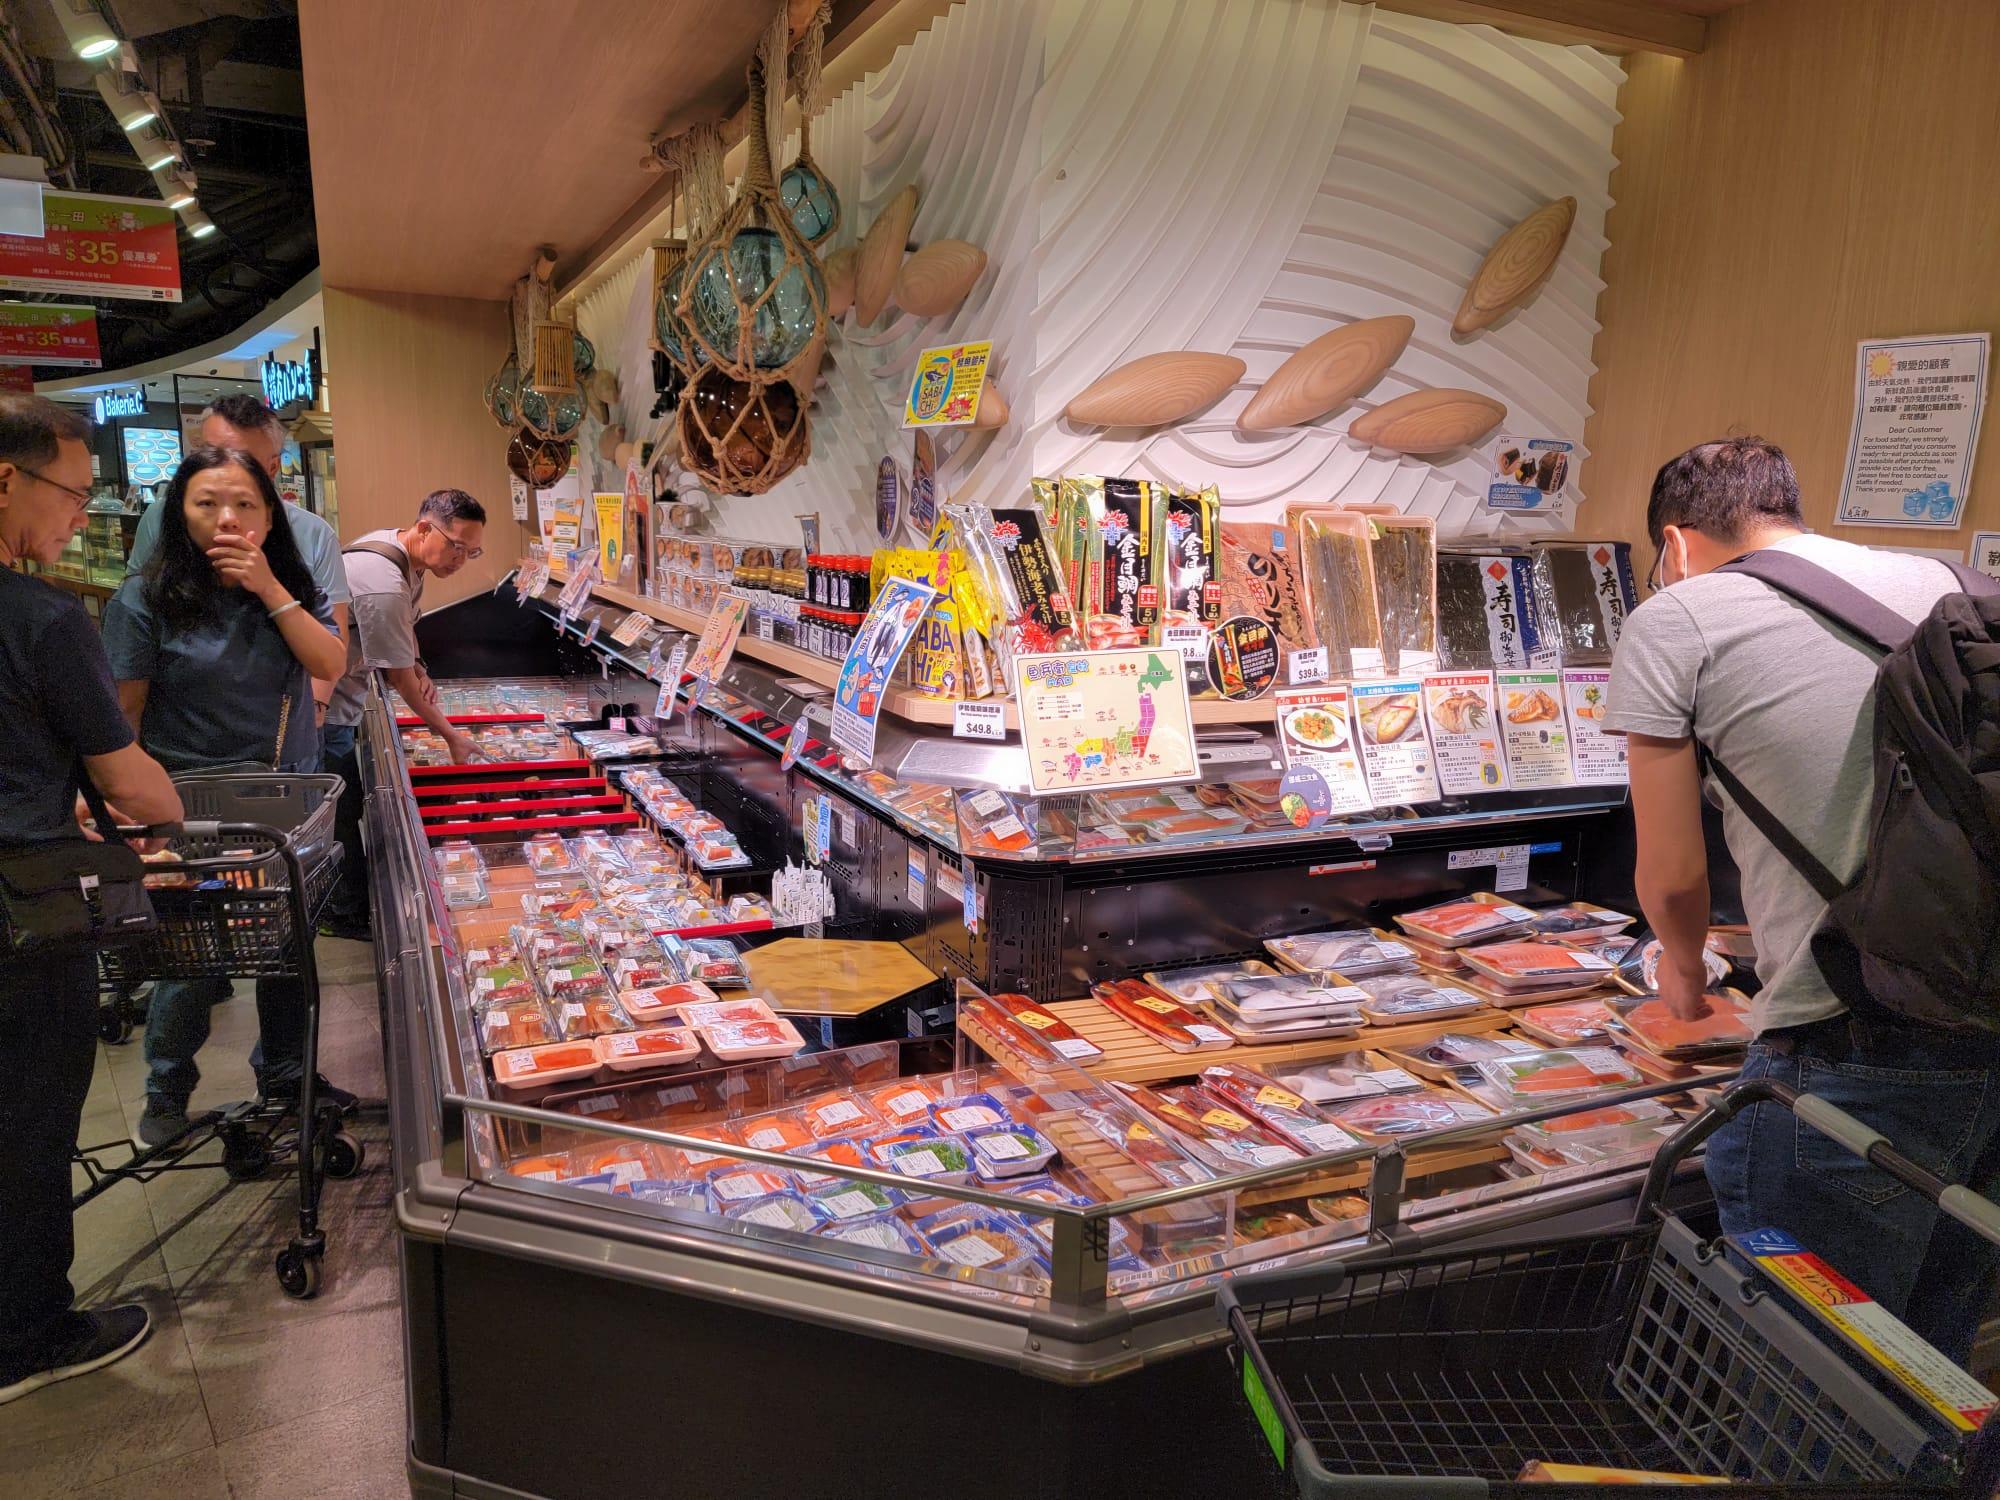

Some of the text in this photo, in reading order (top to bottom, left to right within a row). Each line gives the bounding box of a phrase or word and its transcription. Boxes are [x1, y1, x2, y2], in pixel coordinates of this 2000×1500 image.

[1897, 358, 1950, 371] 親愛的顧客
[105, 391, 143, 417] Bakerie.C
[1861, 450, 1902, 458] ready-to-eat
[1902, 450, 1931, 458] products
[1868, 457, 1894, 465] possible
[916, 619, 955, 653] ABA
[1183, 647, 1195, 658] 9.8
[916, 651, 934, 682] Hi
[1298, 667, 1318, 680] $39.8
[966, 722, 992, 735] $49.8
